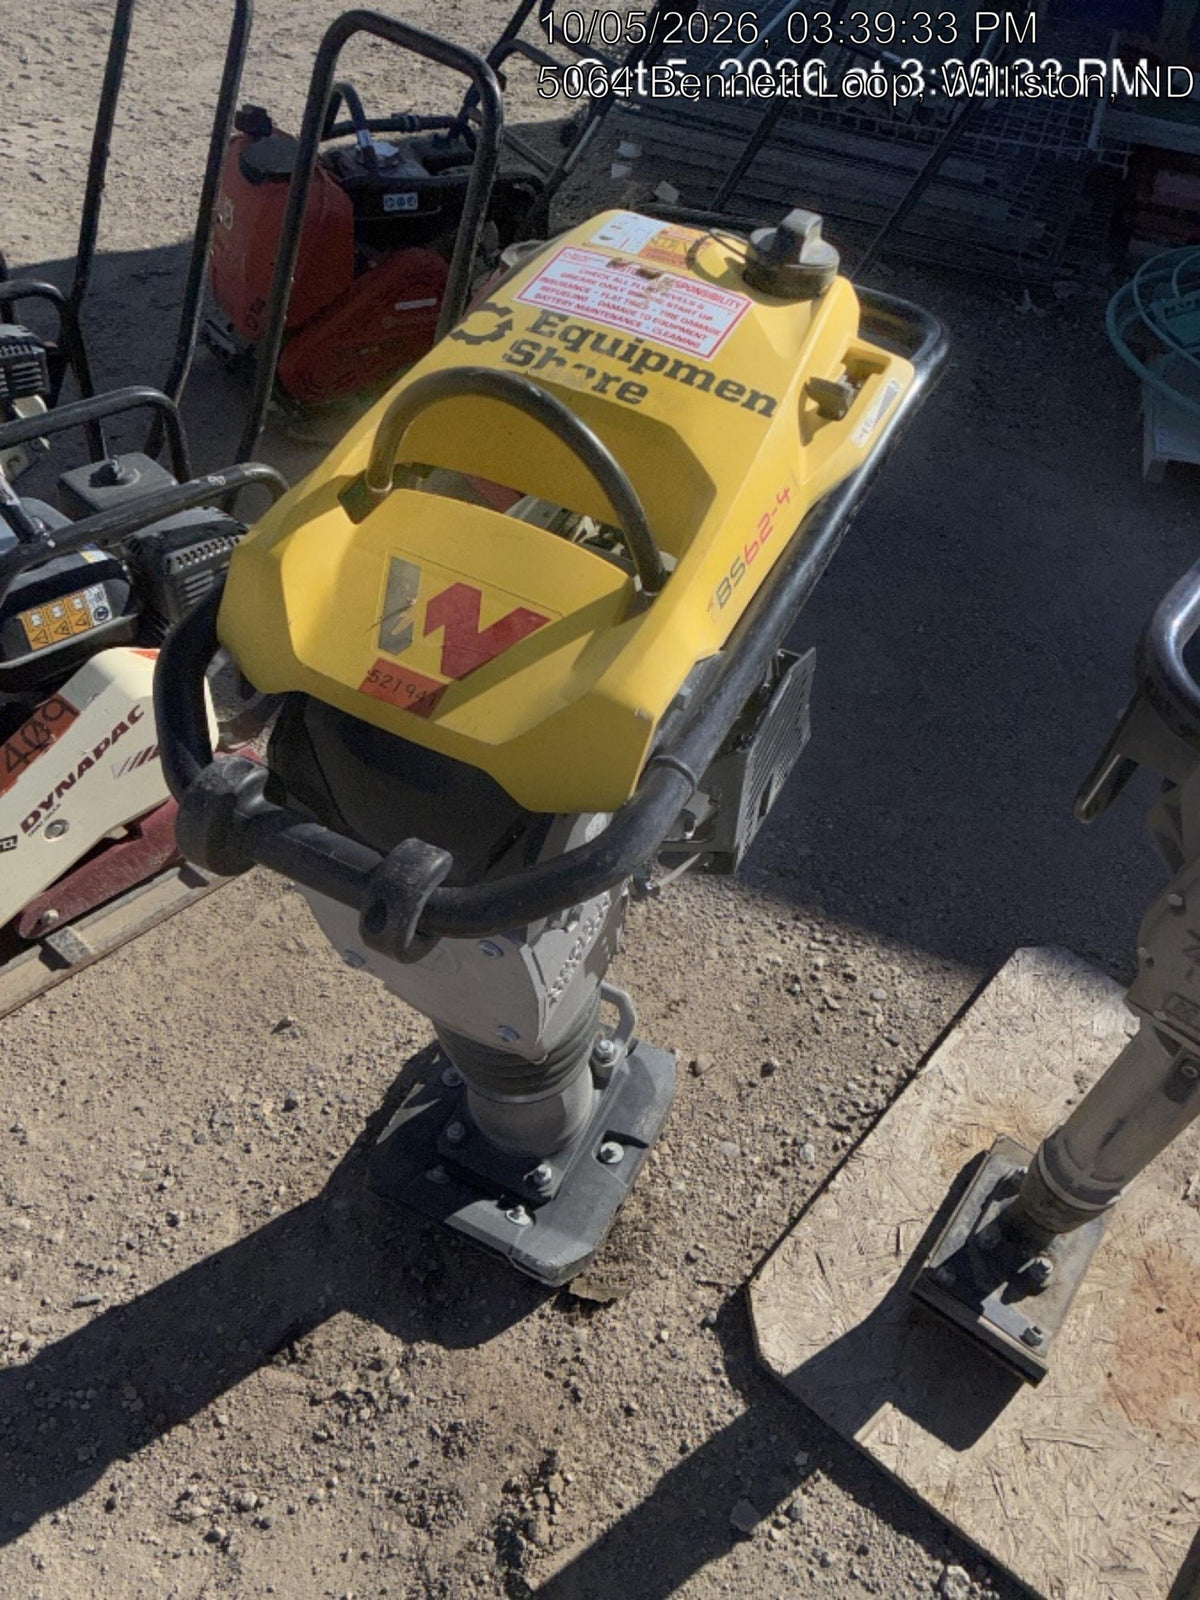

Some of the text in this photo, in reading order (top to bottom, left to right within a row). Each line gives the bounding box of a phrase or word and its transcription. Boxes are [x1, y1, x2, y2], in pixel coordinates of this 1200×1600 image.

[577, 268, 611, 280] CHECK
[611, 276, 629, 284] ALL
[597, 281, 624, 292] DAILY
[533, 292, 701, 348] BATTERY MAINTENANCE CLEANING
[638, 312, 652, 320] TO
[20, 704, 145, 835] DYNAPAC
